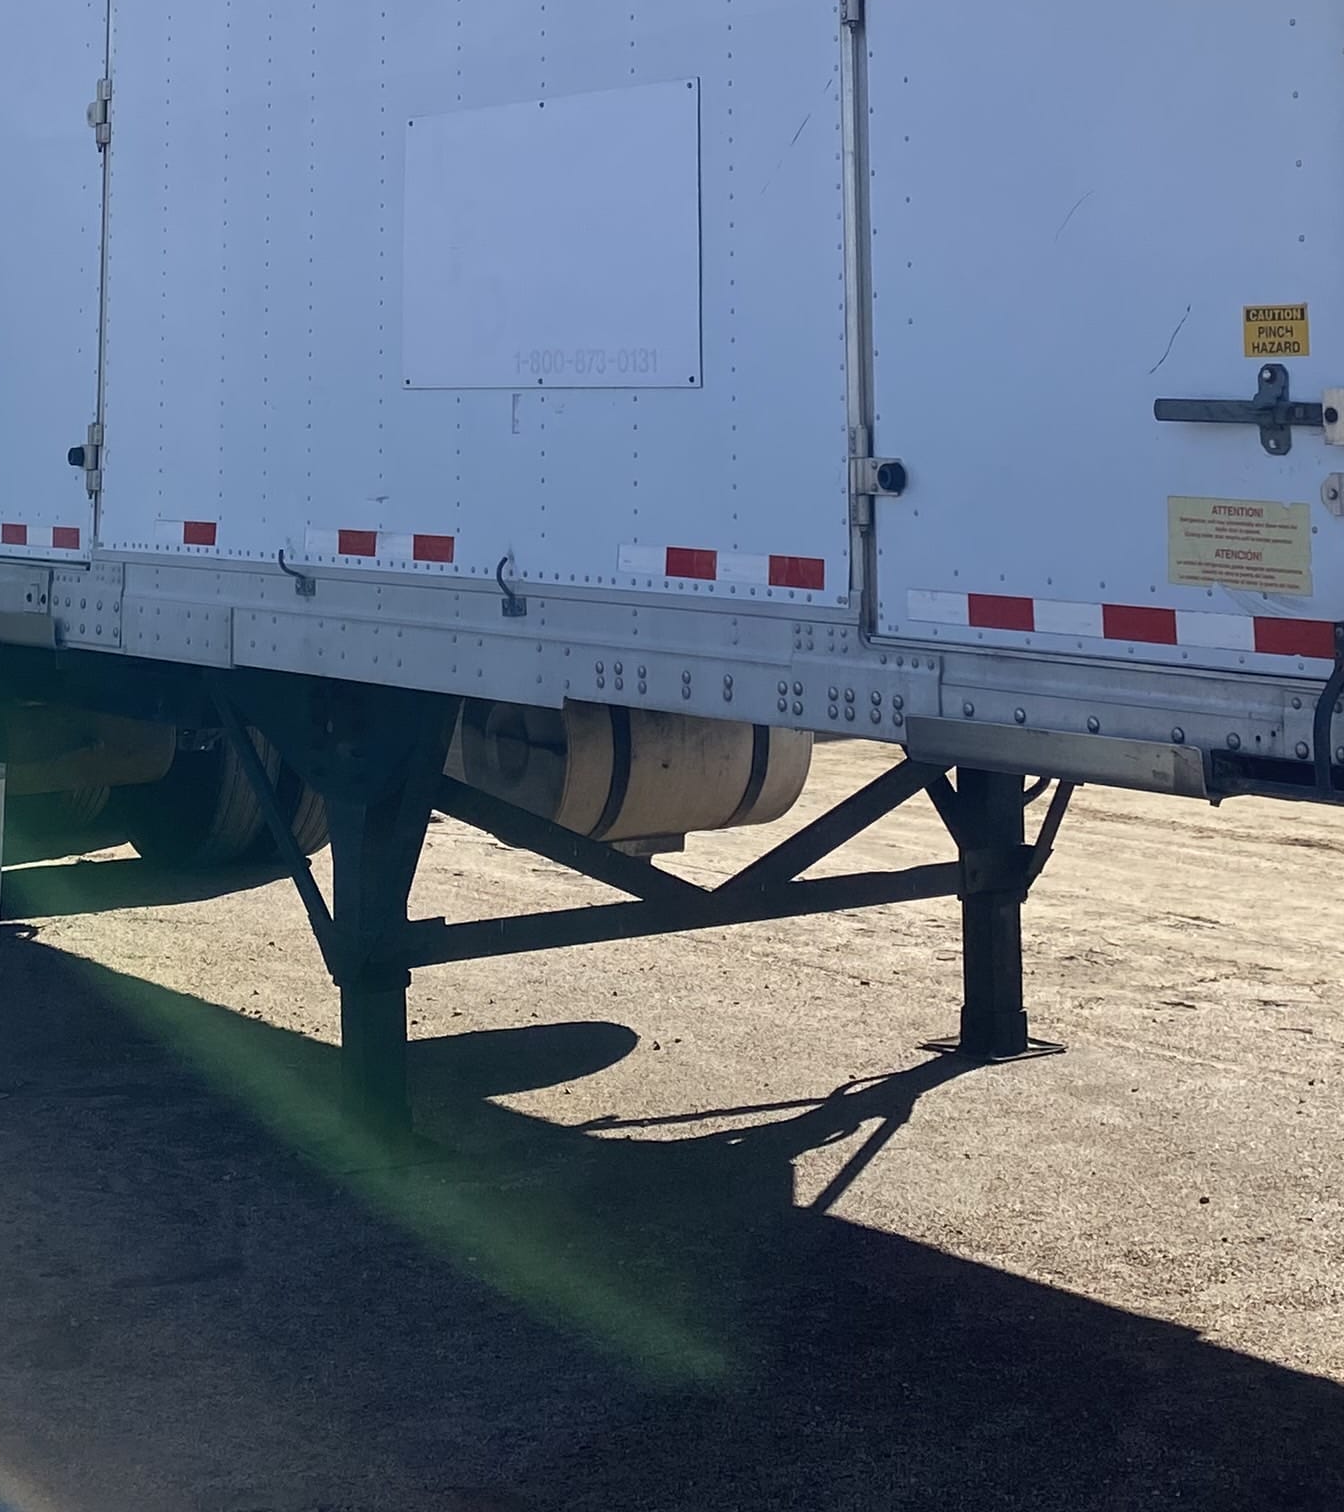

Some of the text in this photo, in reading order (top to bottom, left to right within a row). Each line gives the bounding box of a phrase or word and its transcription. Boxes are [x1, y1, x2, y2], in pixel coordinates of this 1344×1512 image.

[1249, 308, 1301, 321] CAUTION
[1257, 325, 1294, 339] PINCH
[1251, 341, 1301, 354] HAZARD
[1211, 505, 1264, 518] ATTENTION!
